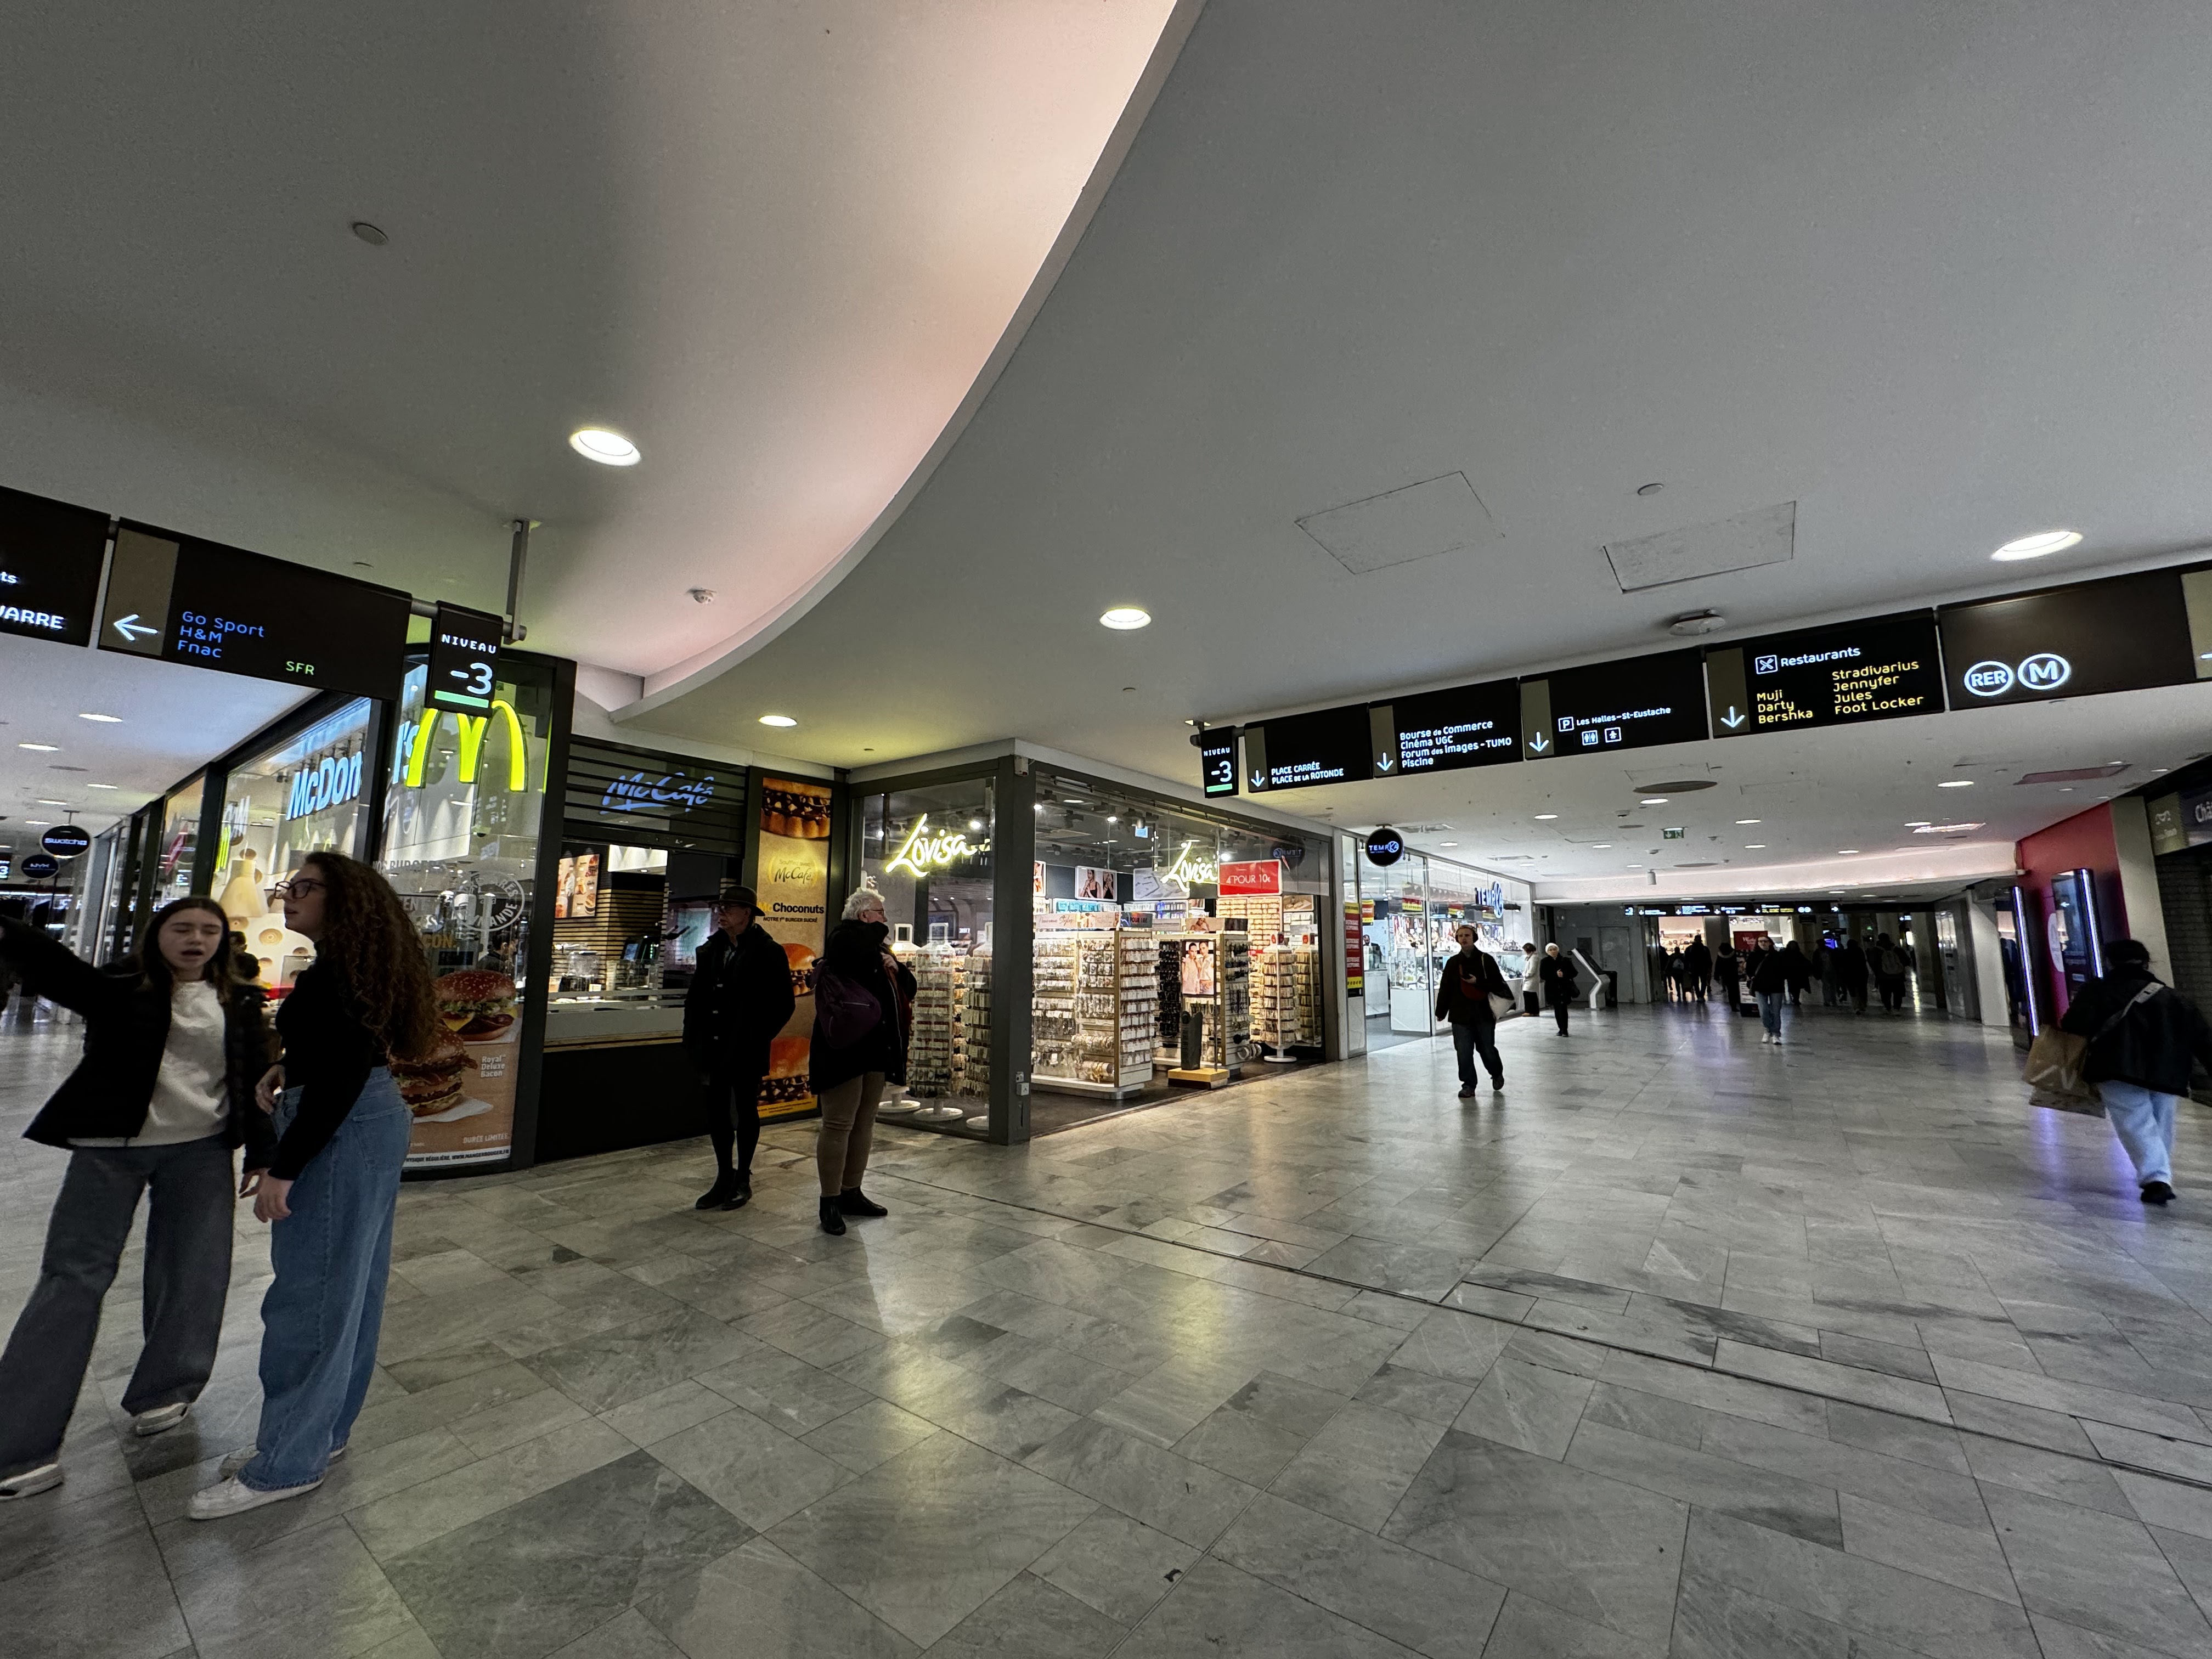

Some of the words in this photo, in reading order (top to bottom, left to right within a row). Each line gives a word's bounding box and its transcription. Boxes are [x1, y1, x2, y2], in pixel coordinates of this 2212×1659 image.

[182, 611, 206, 625] Go
[214, 617, 264, 638] Sport
[180, 625, 222, 643] H&M
[178, 640, 222, 658] Fnac
[442, 634, 496, 654] NIVEAU
[1781, 647, 1861, 667] Restaurants
[286, 661, 315, 675] SFR
[1832, 661, 1919, 680] Stradivarius
[2029, 661, 2057, 682] M
[450, 662, 493, 695] -3
[1833, 675, 1899, 692] Jennyfer
[1971, 670, 2007, 687] RER
[1757, 690, 1782, 702] Muji
[1834, 691, 1872, 704] Jules
[1758, 701, 1794, 713] Darty
[1835, 702, 1867, 714] Foot
[1872, 696, 1924, 710] Locker
[1759, 710, 1813, 724] Bershka
[1400, 730, 1431, 741] Bourse
[1443, 721, 1493, 735] Commerce
[1401, 739, 1433, 749] Cinéma
[1435, 736, 1453, 744] UGC
[1401, 749, 1429, 759] Forum
[1486, 737, 1512, 748] TUMO
[1204, 747, 1230, 757] NIVEAU
[1211, 760, 1232, 782] -3
[1271, 766, 1292, 776] PLACE
[1294, 761, 1320, 773] CARRÉE
[1402, 758, 1434, 768] Piscine
[1272, 775, 1293, 785] PLACE
[1310, 768, 1344, 780] ROTONDE
[885, 812, 978, 878] Lovisa
[1160, 840, 1218, 893] Lovisa
[774, 867, 812, 884] McCafé
[1234, 874, 1256, 884] POUR
